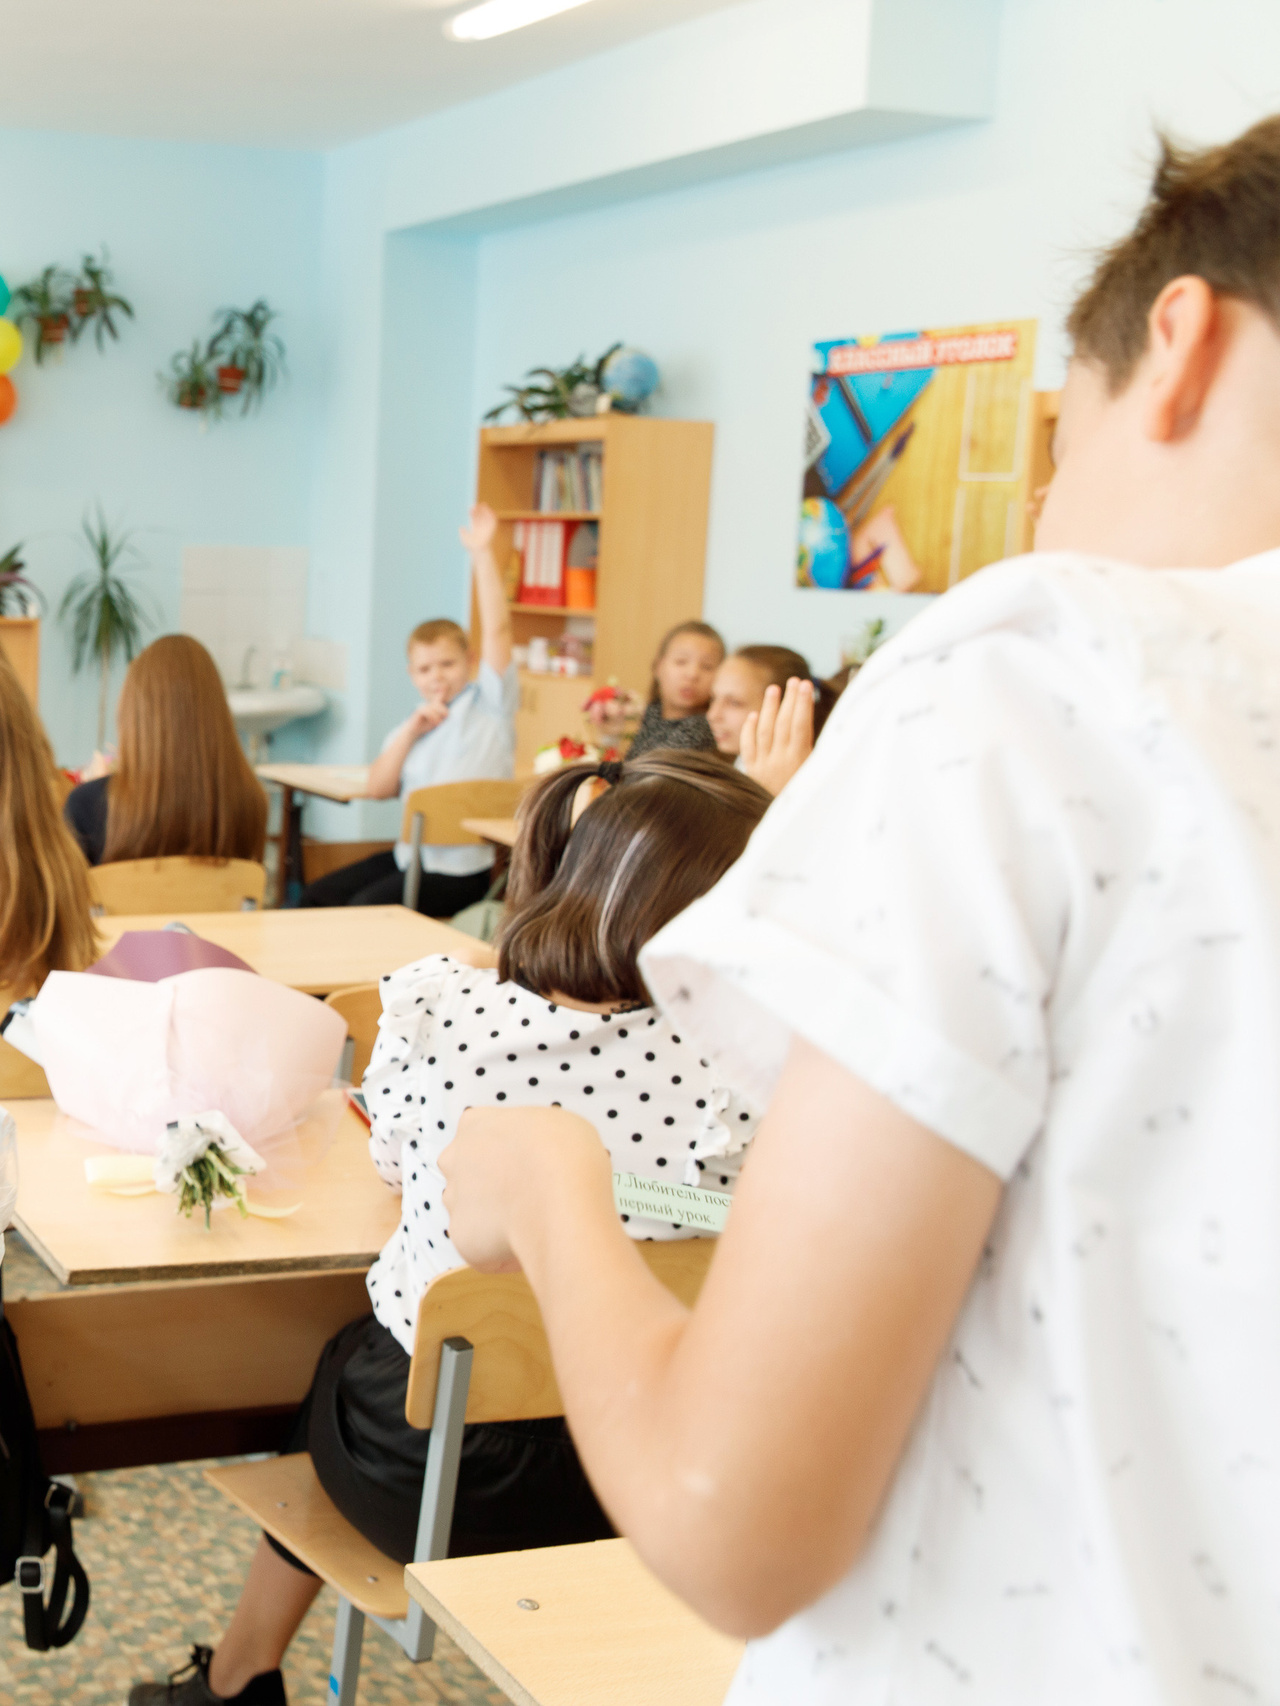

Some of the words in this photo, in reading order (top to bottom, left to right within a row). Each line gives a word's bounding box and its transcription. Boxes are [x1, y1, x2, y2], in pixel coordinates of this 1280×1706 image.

[704, 1195, 732, 1207] пос
[619, 1198, 673, 1216] первый
[677, 1208, 716, 1225] урок.
